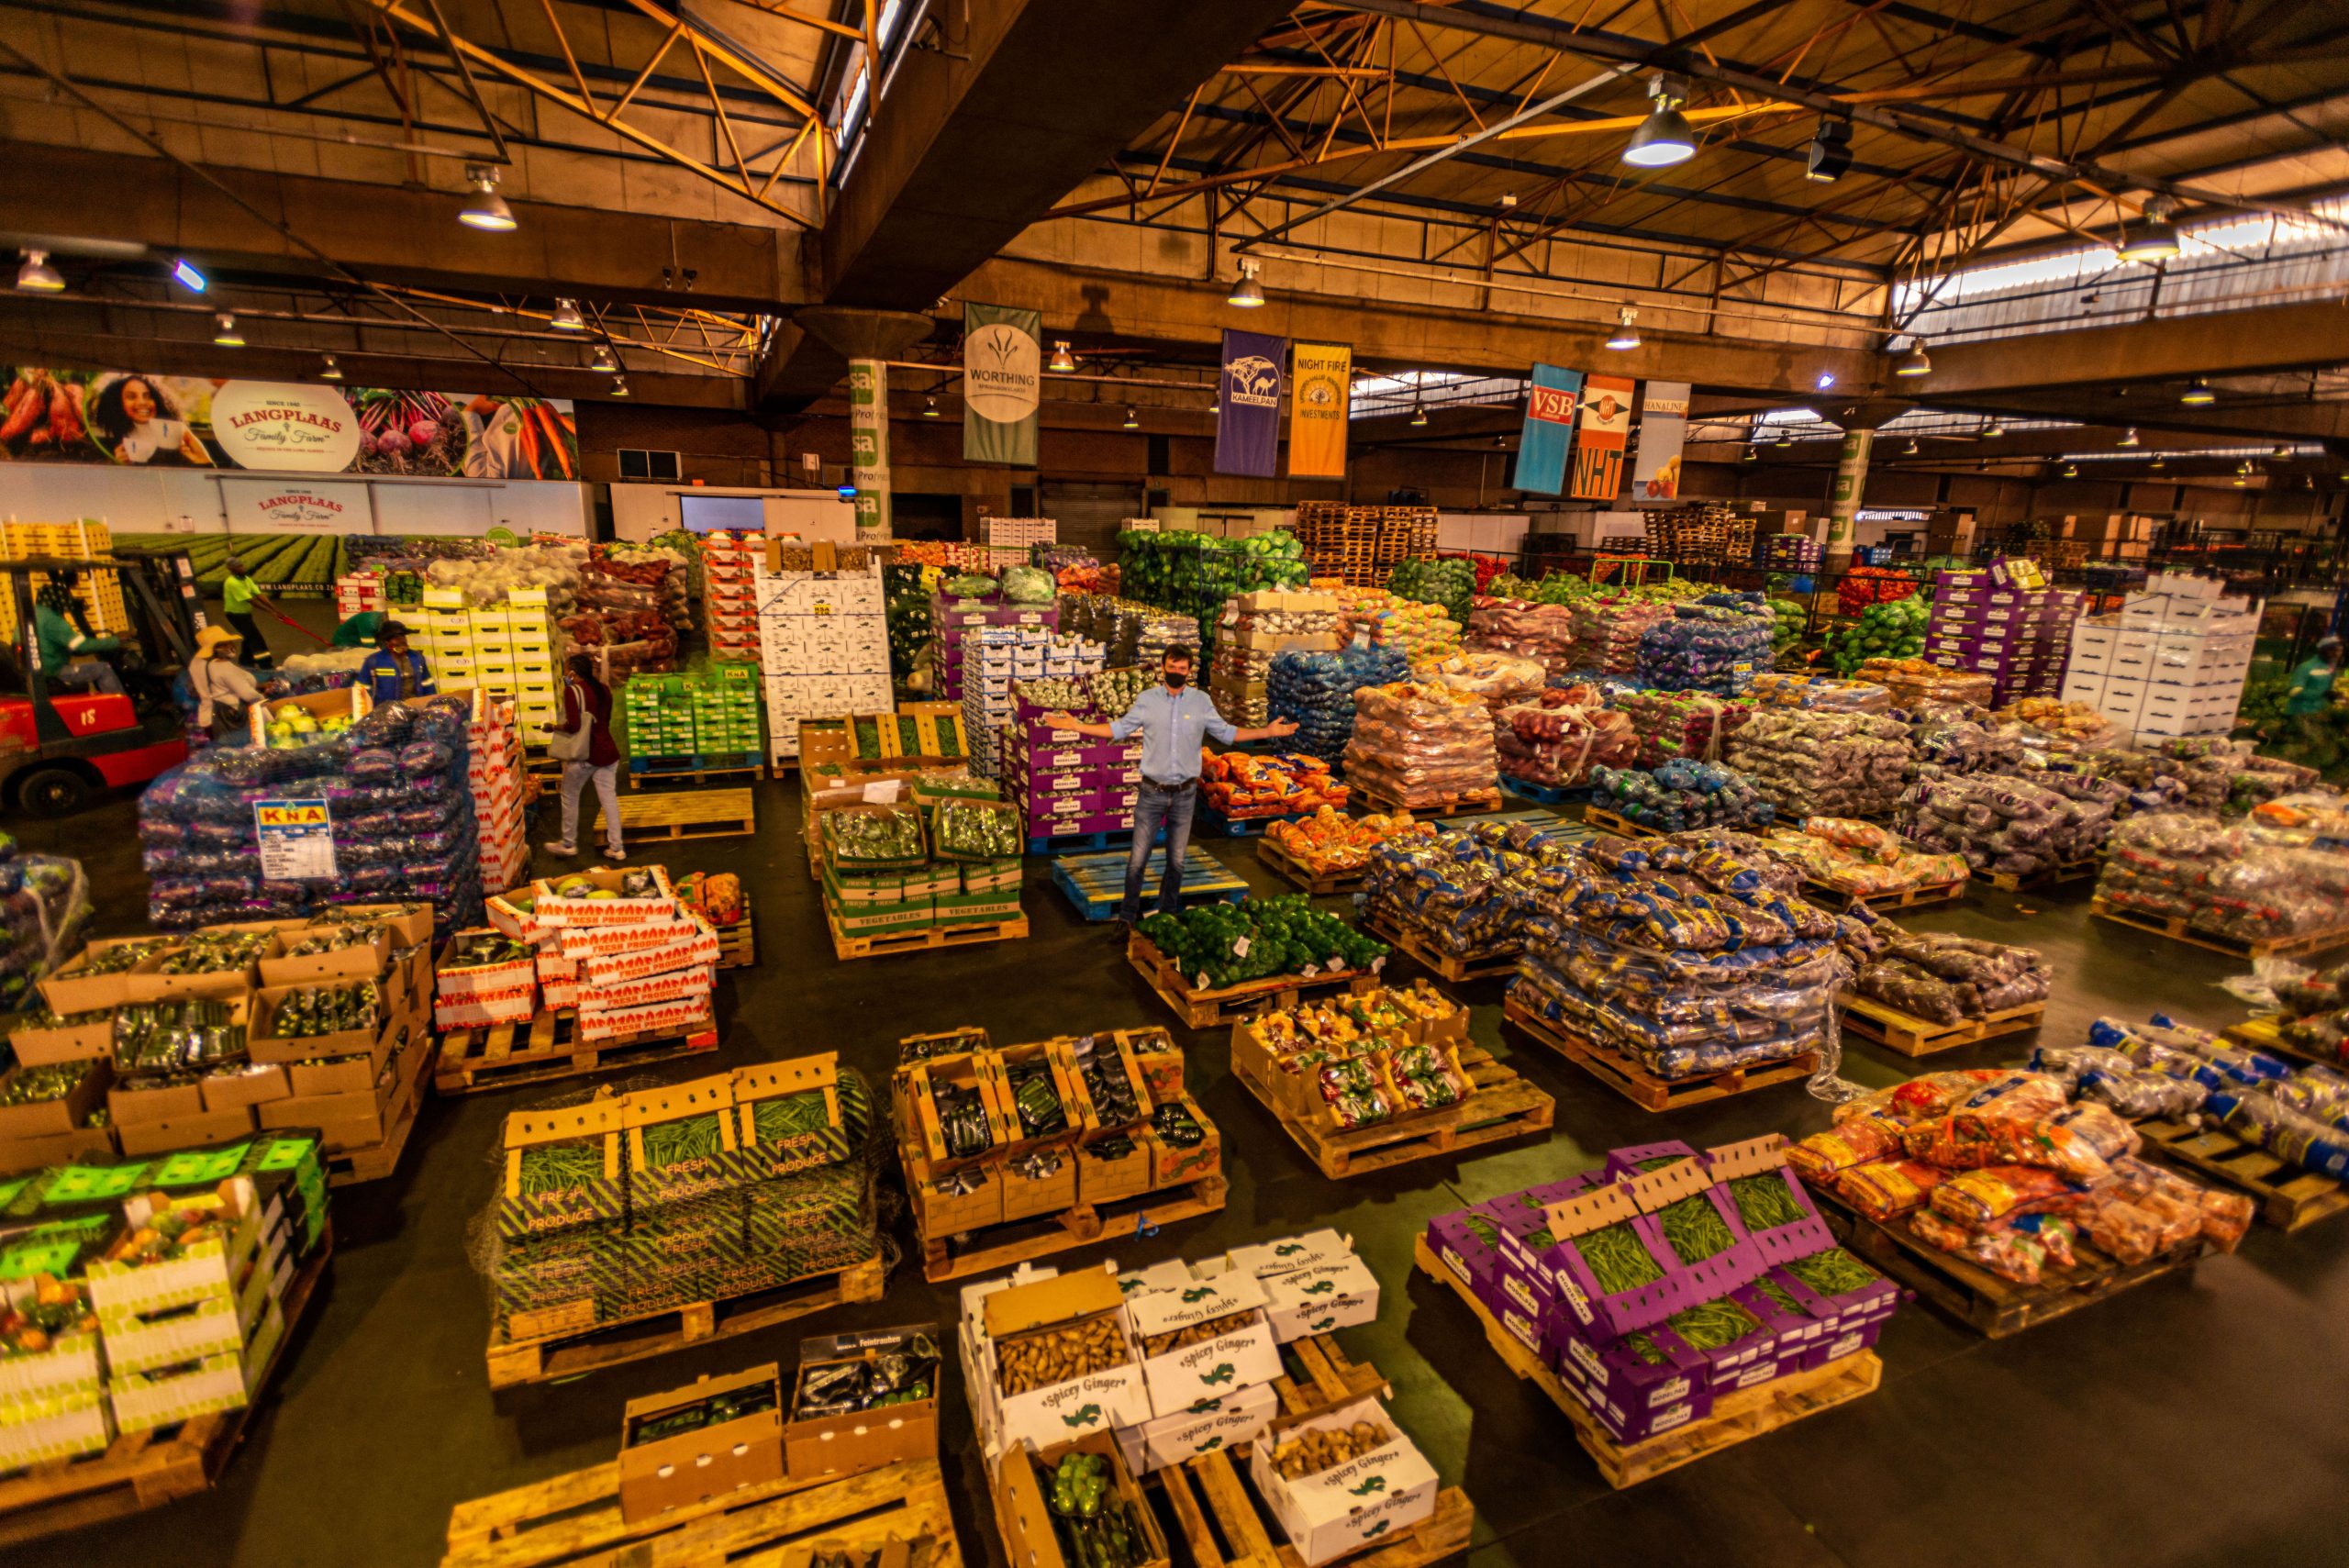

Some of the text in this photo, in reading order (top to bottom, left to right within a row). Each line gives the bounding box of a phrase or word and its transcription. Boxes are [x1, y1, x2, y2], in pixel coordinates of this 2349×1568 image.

[1297, 359, 1346, 372] NIGHT FIRE
[970, 369, 1035, 385] WORTHING
[1232, 394, 1277, 406] KAMEELPAN
[1533, 391, 1574, 416] VSB
[1600, 398, 1616, 417] NHT
[1644, 401, 1684, 412] HANALINE
[228, 408, 341, 433] LANGPLAAS
[1300, 409, 1340, 419] INVESTMENTS
[244, 428, 286, 445] Family
[1573, 447, 1622, 497] NHT
[258, 495, 343, 513] LANGPLAAS
[269, 509, 301, 522] Family
[996, 863, 1018, 872] FRESH
[906, 875, 929, 884] FRESH
[860, 912, 920, 926] VEGETABLES
[950, 905, 1008, 915] VEGETABLES
[593, 939, 670, 953] FRESH PRODUCE
[618, 955, 694, 978] FRESH PRODUCE
[607, 988, 684, 1006] FRESH PRODUCE
[610, 1016, 686, 1033] FRESH PRODUCE
[776, 1133, 816, 1151] FRESH
[666, 1158, 708, 1175] FRESH
[771, 1152, 826, 1175] PRODUCE
[539, 1186, 584, 1206] FRESH
[659, 1178, 718, 1200] PRODUCE
[529, 1207, 593, 1230] PRODUCE
[785, 1214, 826, 1229] FRESH
[664, 1240, 709, 1255] FRESH
[778, 1229, 835, 1249] PRODUCE
[657, 1257, 718, 1277] PRODUCE
[803, 1251, 859, 1272] PRODUCE
[1444, 1253, 1469, 1280] MODELPAK
[537, 1265, 587, 1283] FRESH
[723, 1264, 766, 1280] FRESH
[529, 1283, 595, 1302] PRODUCE
[628, 1282, 673, 1298] FRESH
[716, 1274, 775, 1295] PRODUCE
[619, 1293, 683, 1314] PRODUCE
[1507, 1282, 1537, 1312] MODELPAK
[1559, 1273, 1588, 1320] MODELPAK
[860, 1336, 901, 1348] Feintrauben
[1572, 1347, 1605, 1379] MODELPAK
[1653, 1387, 1686, 1403] MODELPAK
[1654, 1412, 1688, 1429] MODELPAK
